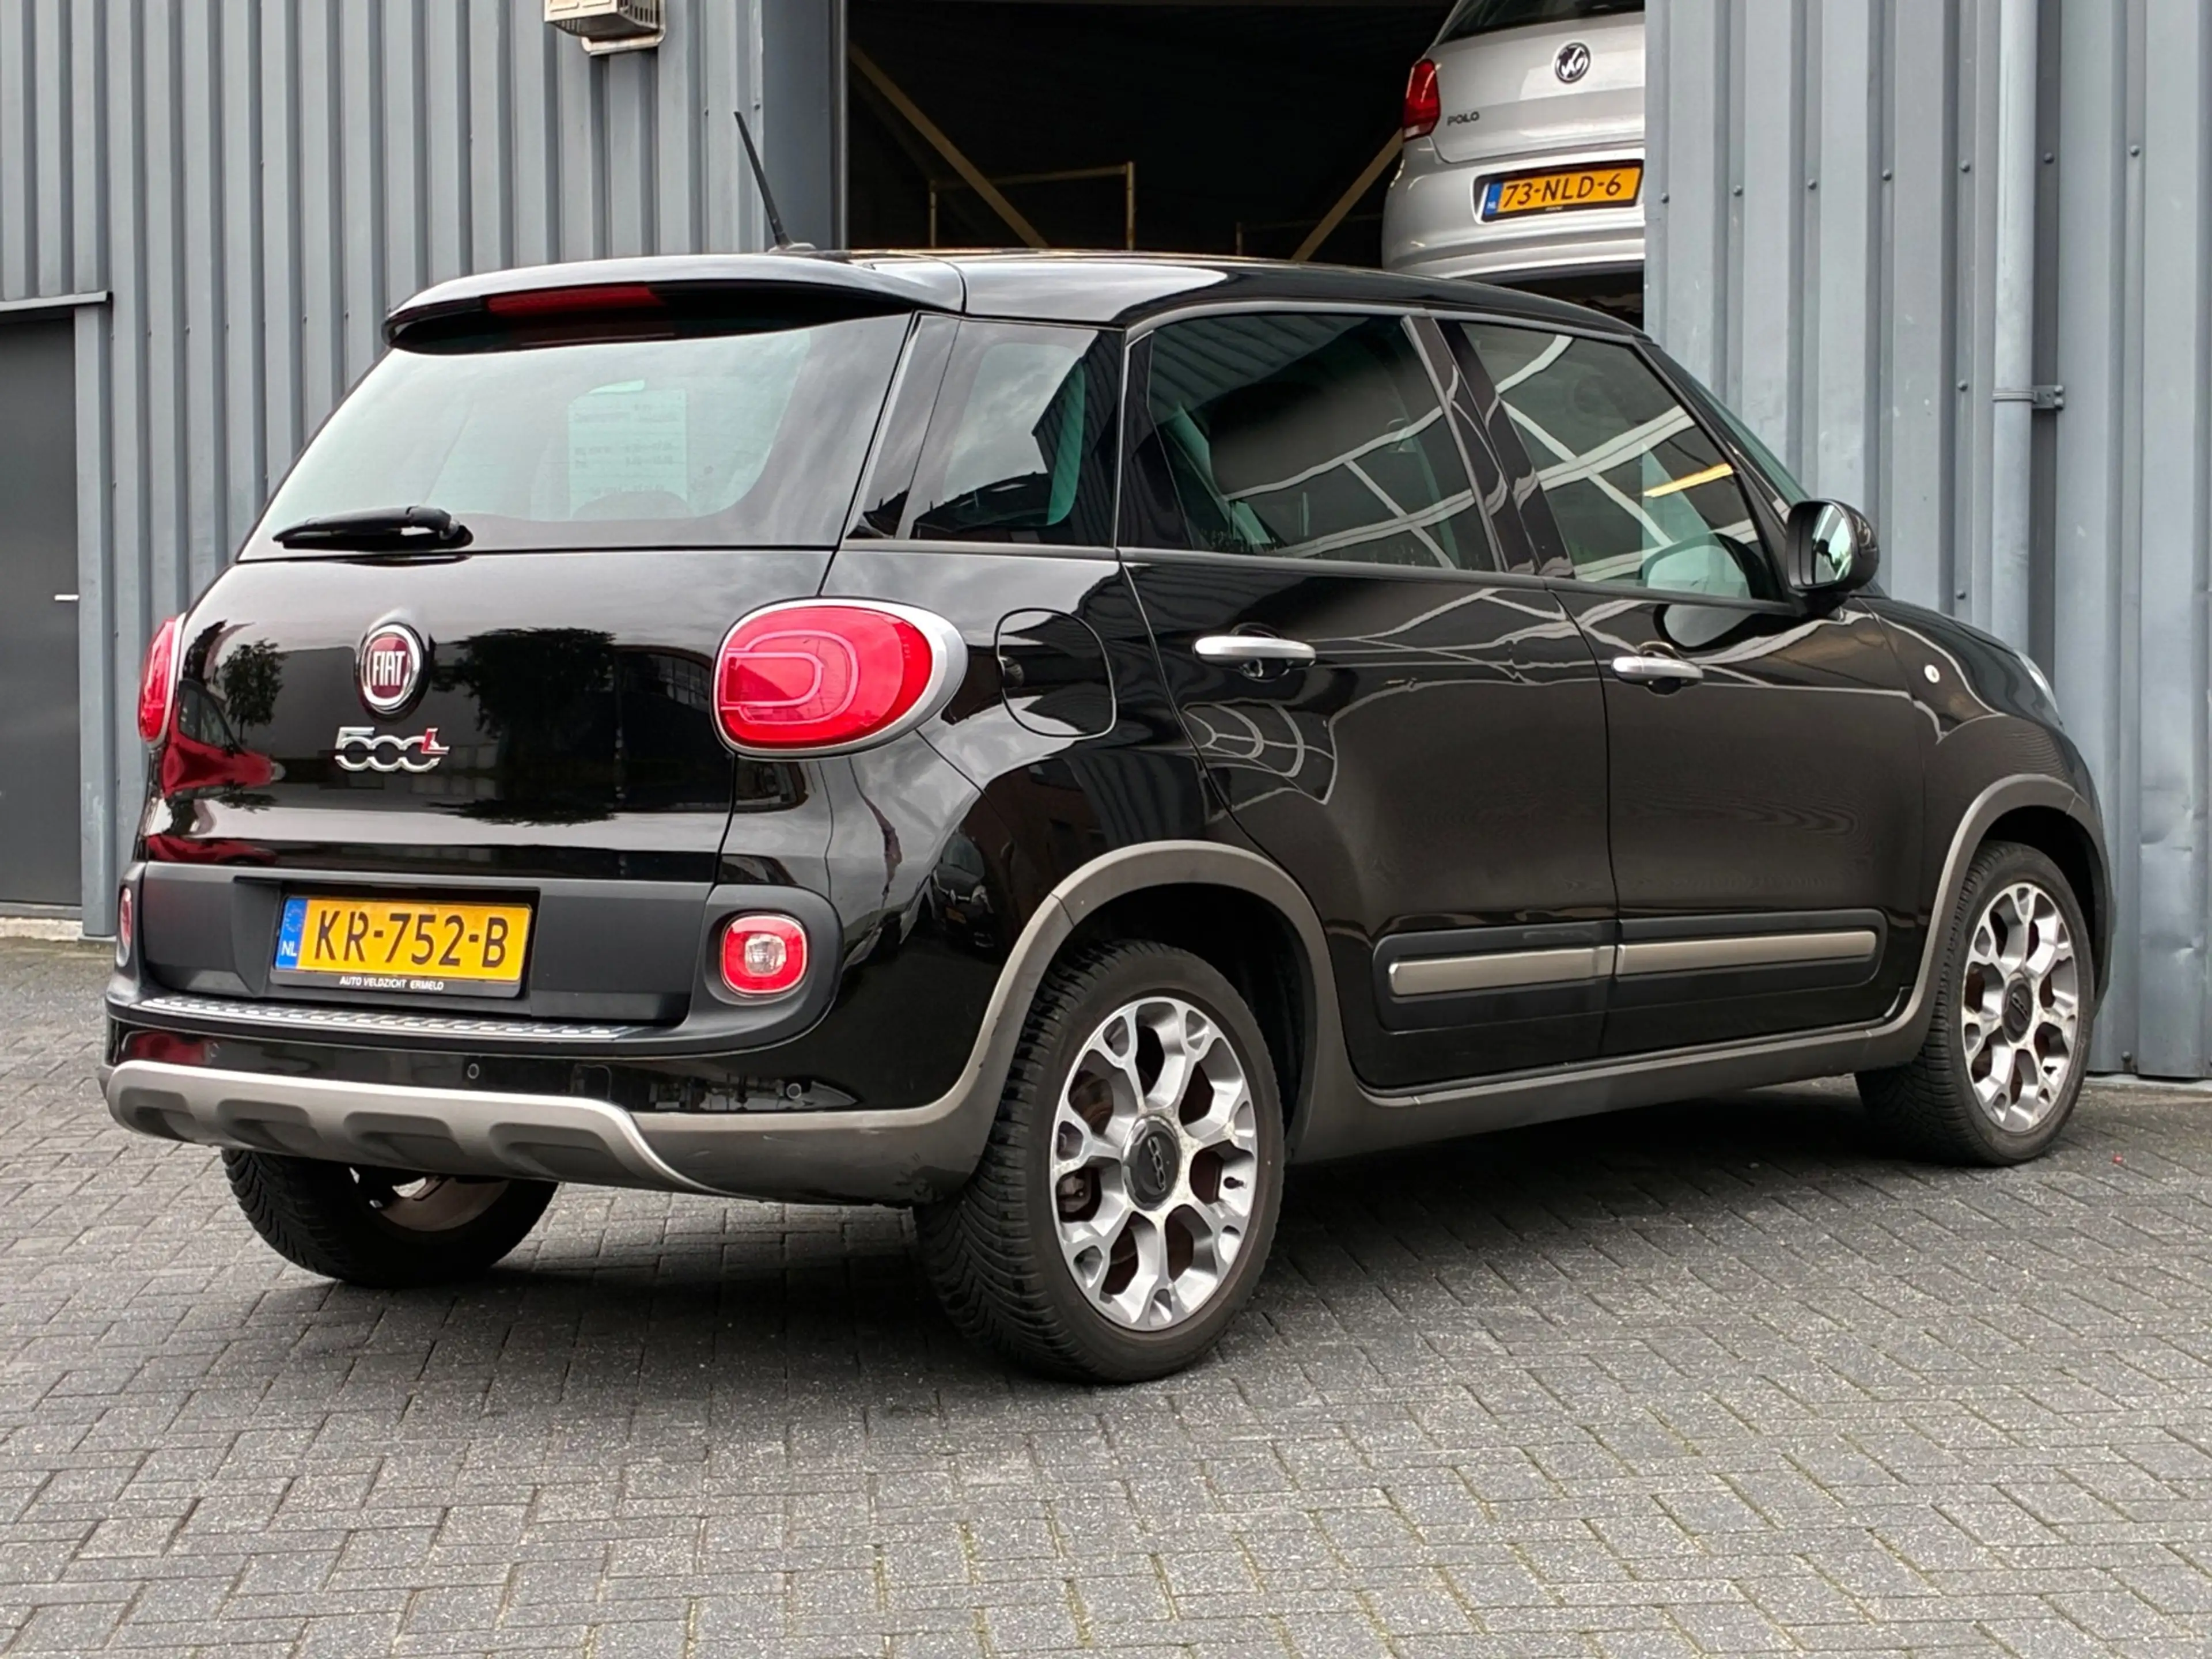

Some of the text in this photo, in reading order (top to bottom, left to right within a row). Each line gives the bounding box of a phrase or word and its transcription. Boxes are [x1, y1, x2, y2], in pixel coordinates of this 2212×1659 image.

[1447, 111, 1480, 126] POLO
[1503, 173, 1622, 208] 73-NLD-6
[372, 650, 406, 686] FIAT
[334, 726, 450, 772] 500L
[281, 940, 297, 957] NL
[315, 910, 510, 968] KR-752-B
[339, 976, 444, 990] AUTO VELDZICHT ERMELO
